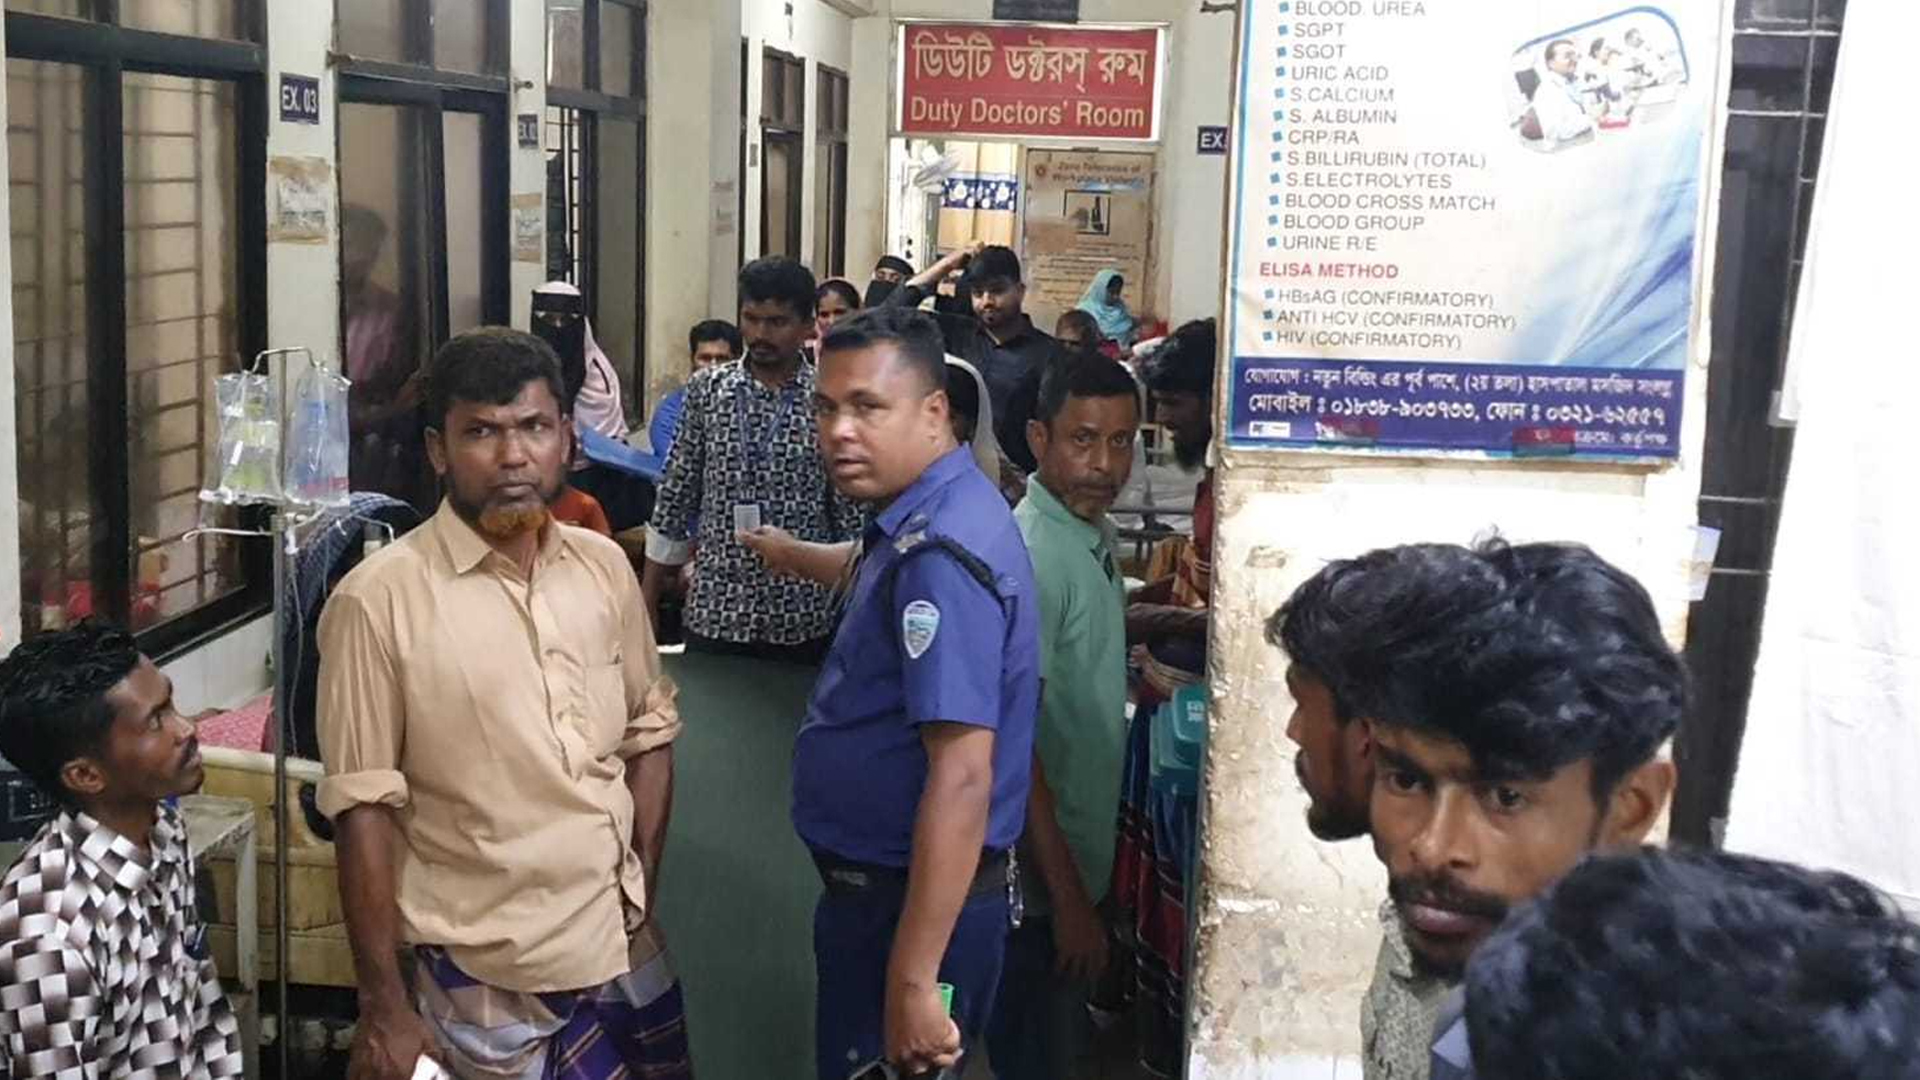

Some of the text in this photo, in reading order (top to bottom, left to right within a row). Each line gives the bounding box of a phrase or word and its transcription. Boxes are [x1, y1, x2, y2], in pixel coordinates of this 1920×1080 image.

[1373, 1, 1425, 16] UREA
[1294, 22, 1345, 38] SGPT
[912, 29, 994, 81] ডিউটি
[1098, 46, 1148, 86] রুম
[1292, 44, 1347, 60] SGOT
[1291, 65, 1389, 81] URIC ACID
[303, 88, 317, 114] 03
[1290, 86, 1394, 103] S.CALCIUM
[911, 96, 1145, 128] Duty Doctors' Room
[1312, 109, 1397, 125] ALBUMIN
[1288, 129, 1360, 145] CRP/RA
[1414, 151, 1487, 170] (TOTAL)
[1285, 193, 1496, 211] BLOOD CROSS MATCH
[1284, 213, 1425, 231] BLOOD GROUP
[1283, 235, 1378, 252] URINE R/E
[1260, 262, 1399, 279] ELISA METHOD
[1279, 288, 1494, 309] HBsAG (CONFIRMATORY)
[1277, 309, 1517, 331] ANTI HCV (CONFIRMATORY)
[1277, 330, 1461, 350] HIV (CONFIRMATORY)
[1244, 368, 1300, 385] যোগাযোগ
[1313, 369, 1343, 389] নতুন
[1381, 371, 1400, 388] এর
[1249, 391, 1312, 414] মোবাইল
[1486, 401, 1526, 422] ফোন
